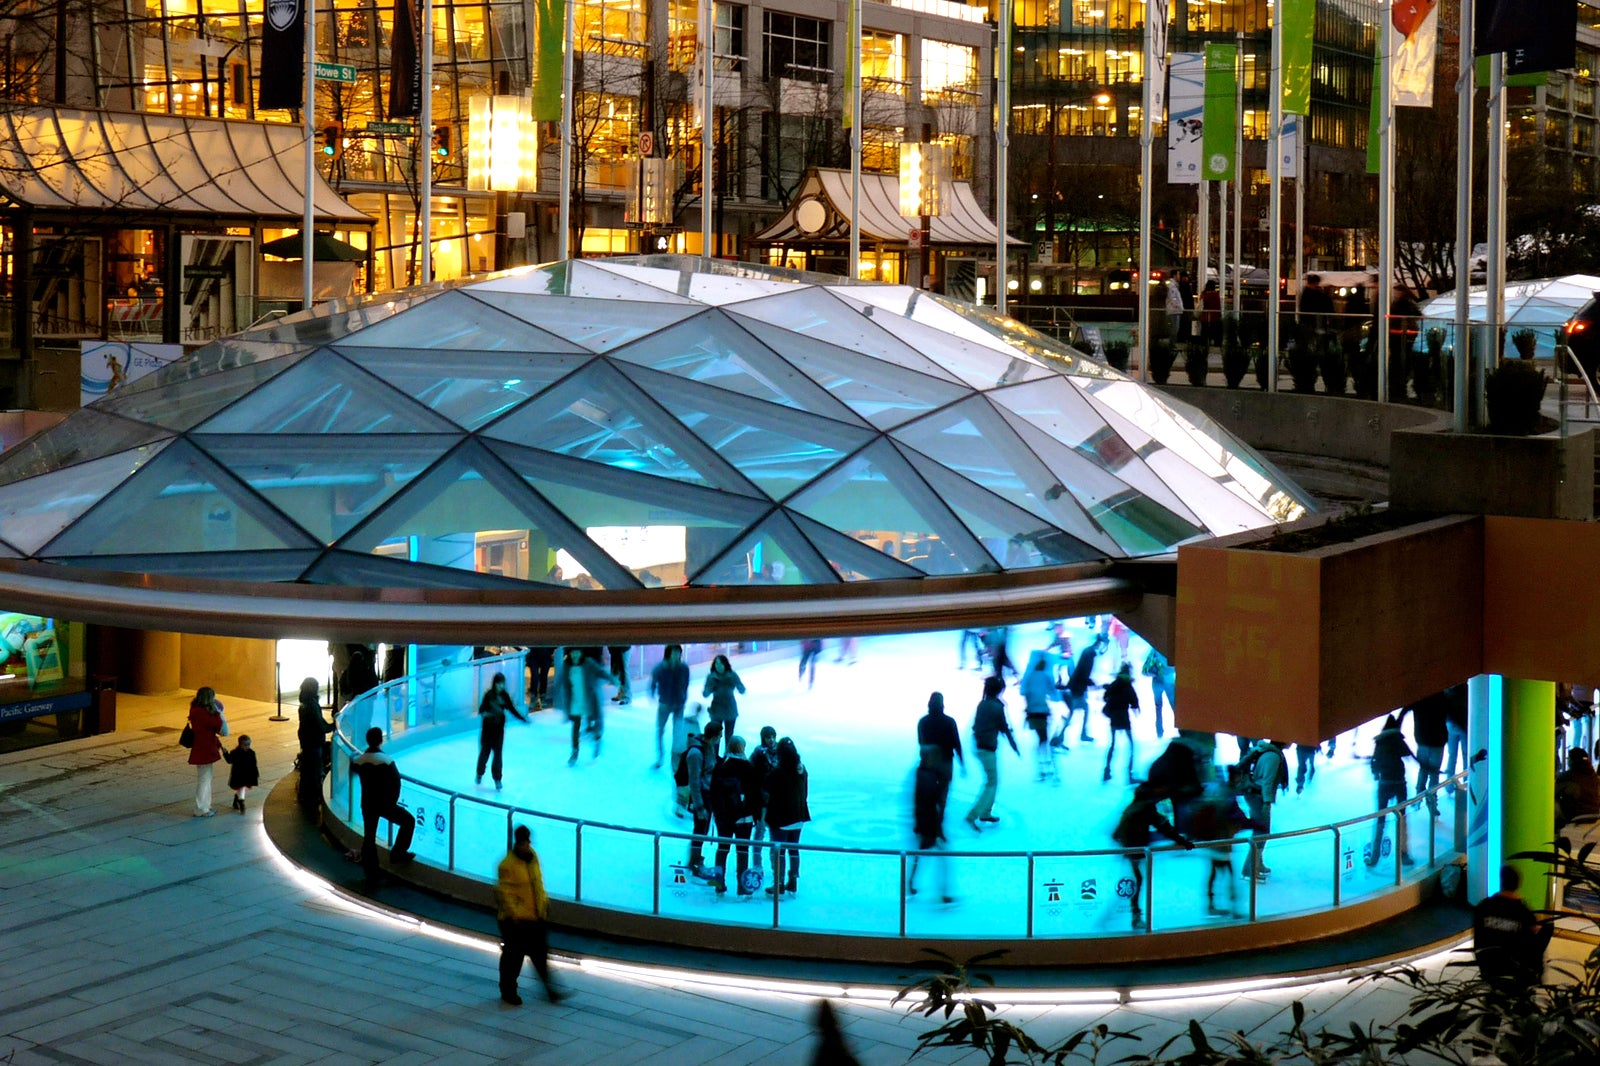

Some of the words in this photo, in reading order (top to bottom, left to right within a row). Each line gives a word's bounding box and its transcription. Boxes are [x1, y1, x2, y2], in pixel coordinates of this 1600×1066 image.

[315, 64, 339, 78] Howe
[342, 68, 352, 80] St
[412, 92, 420, 110] THE
[134, 358, 143, 367] GE
[1, 705, 22, 717] Pacific
[24, 703, 54, 713] Gateway
